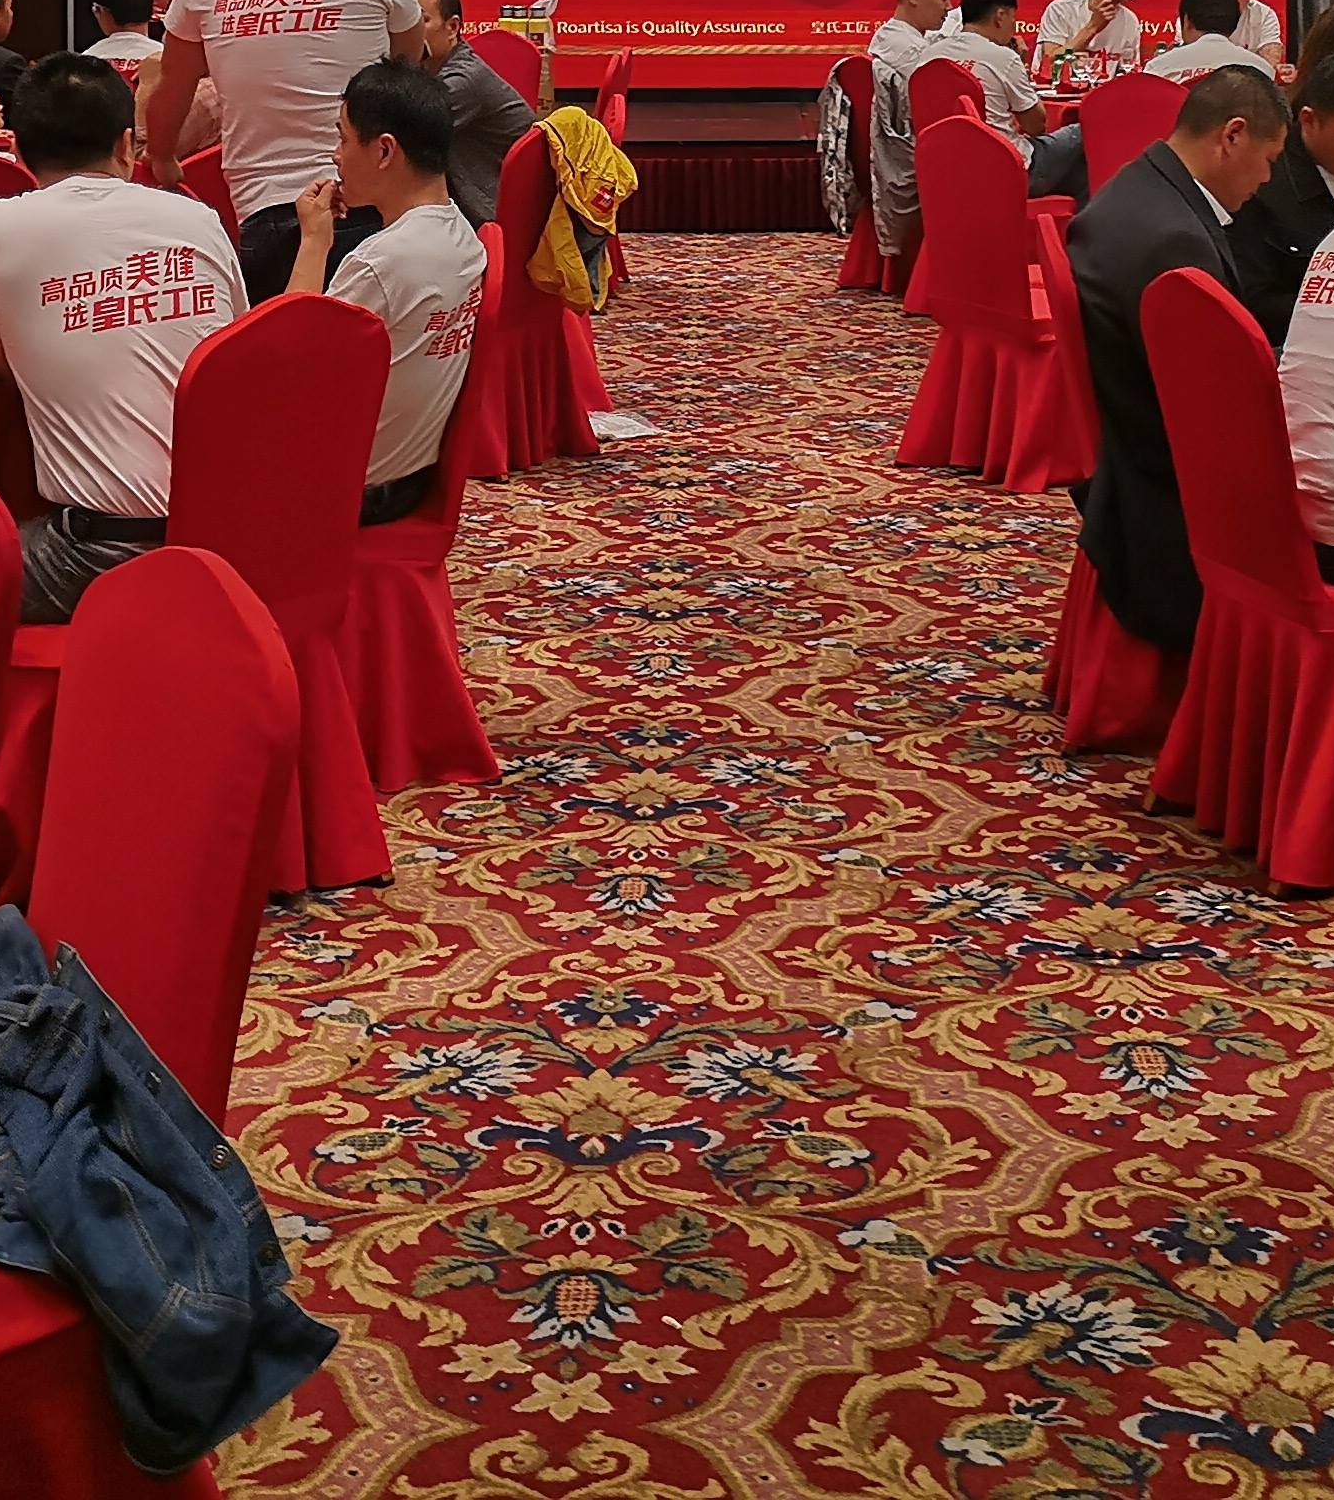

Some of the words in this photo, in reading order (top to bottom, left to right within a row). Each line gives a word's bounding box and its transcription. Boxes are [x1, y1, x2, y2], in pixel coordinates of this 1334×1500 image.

[220, 8, 344, 38] 选皇氏工匠
[556, 20, 623, 34] Roartisa
[626, 20, 640, 34] is
[642, 20, 701, 37] Quality
[702, 20, 786, 34] Assurance
[40, 246, 196, 307] 高品质美缝
[63, 283, 217, 333] 选皇氏工匠
